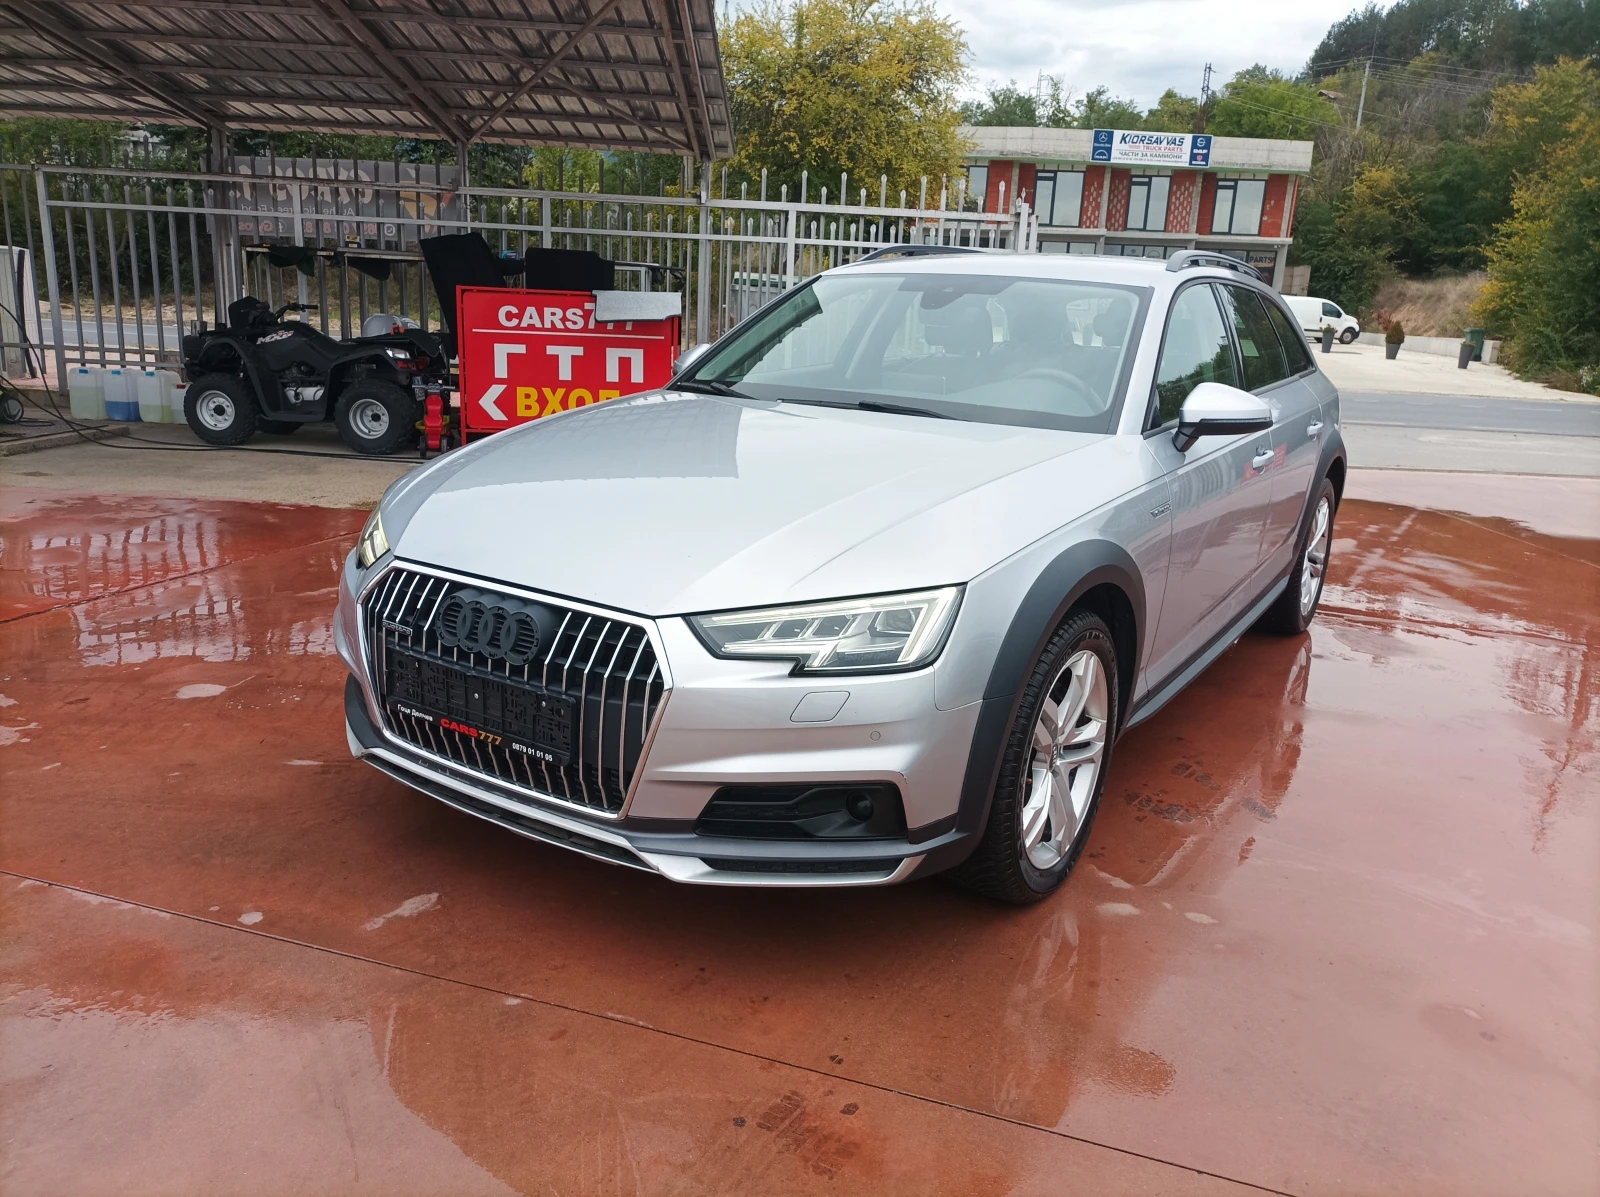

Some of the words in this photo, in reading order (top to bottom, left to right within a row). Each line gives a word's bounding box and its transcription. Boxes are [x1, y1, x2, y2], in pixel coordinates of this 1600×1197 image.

[1120, 133, 1185, 147] KIORSAVVAS
[1149, 152, 1183, 160] КАМИОНИ
[1249, 255, 1273, 264] PARTS
[498, 302, 633, 331] CARS7
[440, 717, 503, 746] CARS777
[512, 743, 527, 753] 0879
[527, 747, 536, 756] 01
[536, 750, 545, 760] 01
[544, 753, 554, 763] 05
